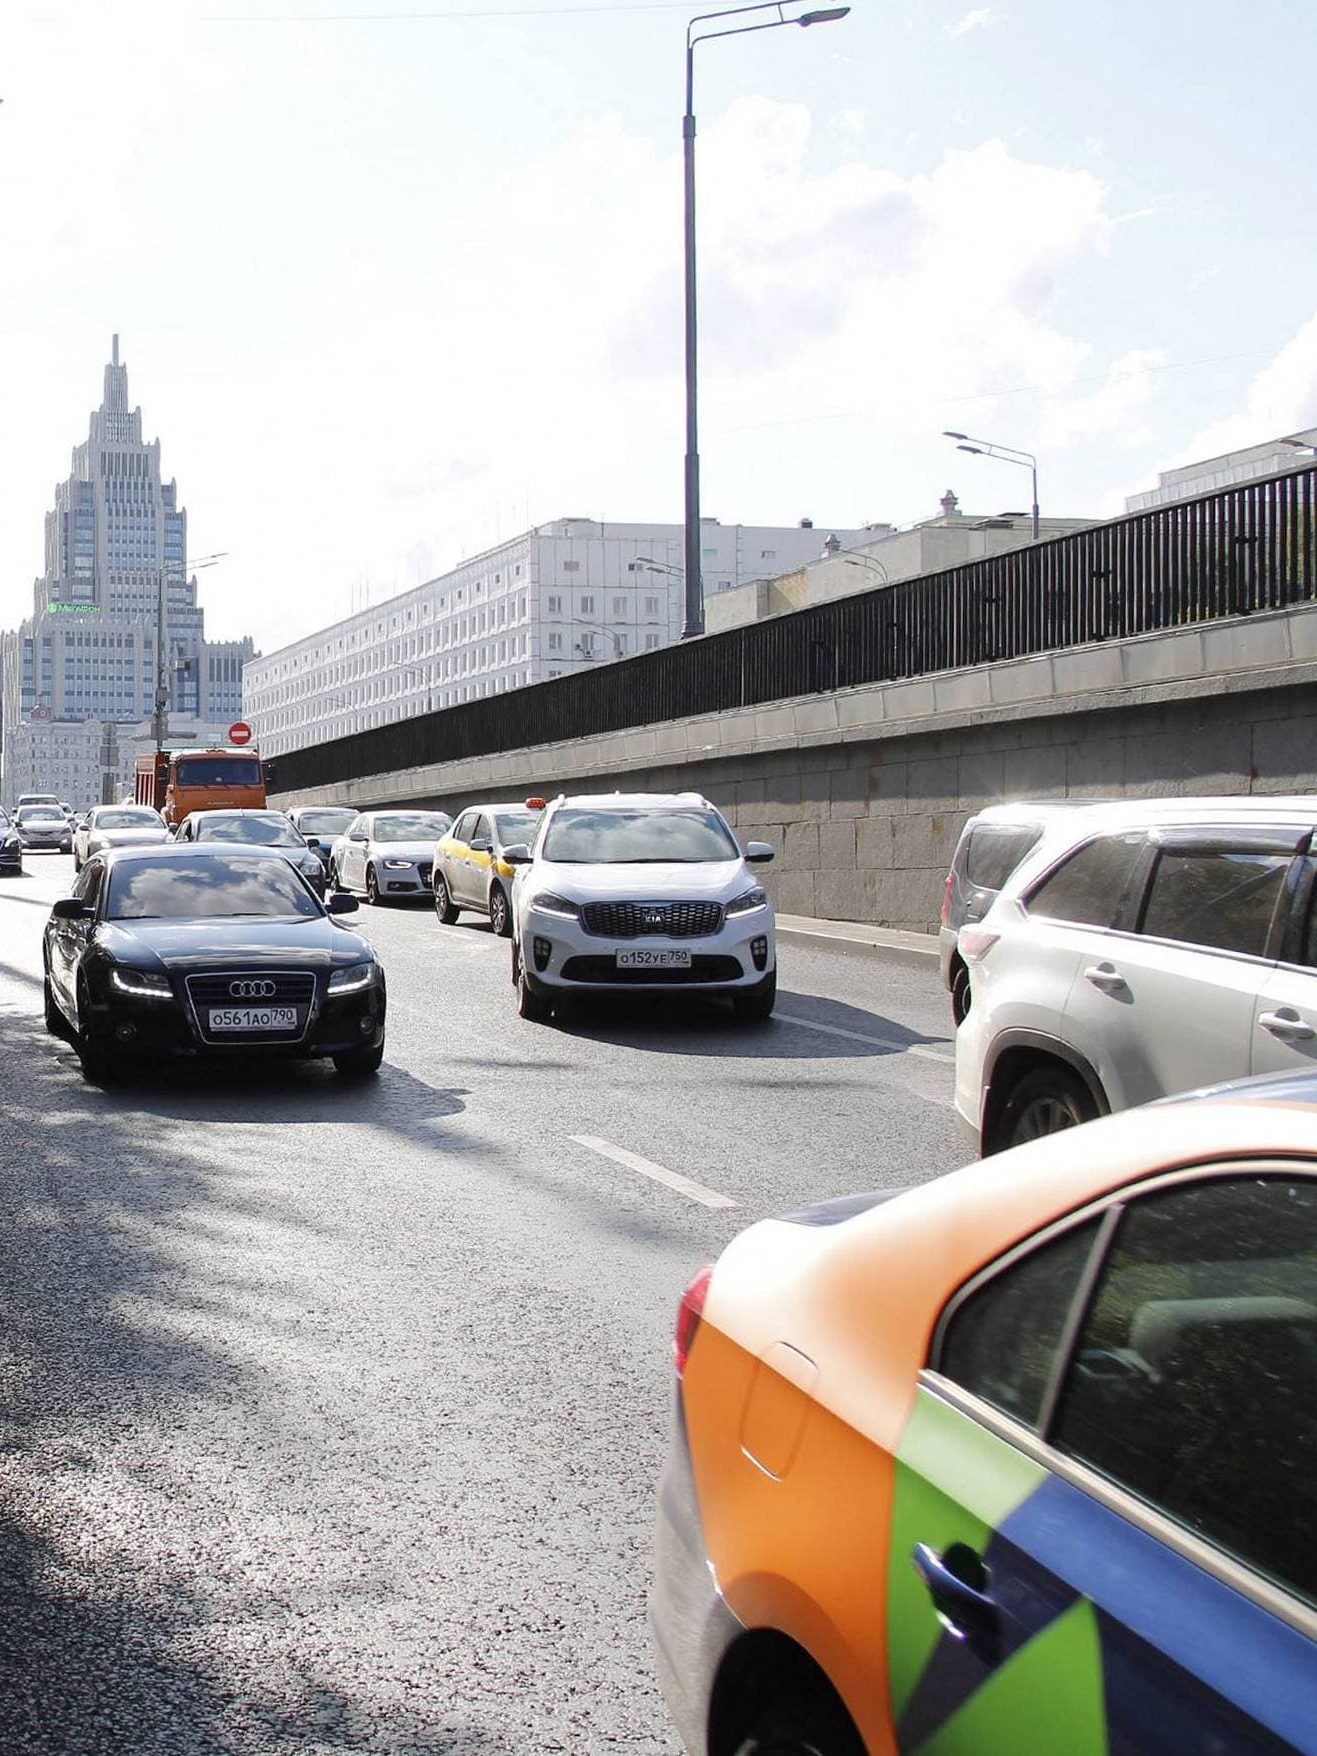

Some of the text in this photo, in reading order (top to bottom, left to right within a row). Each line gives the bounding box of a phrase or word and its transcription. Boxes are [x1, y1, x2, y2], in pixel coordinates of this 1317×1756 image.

[645, 915, 661, 923] KIA
[621, 951, 667, 964] О152УЕ
[213, 1009, 293, 1025] О561АО 790
